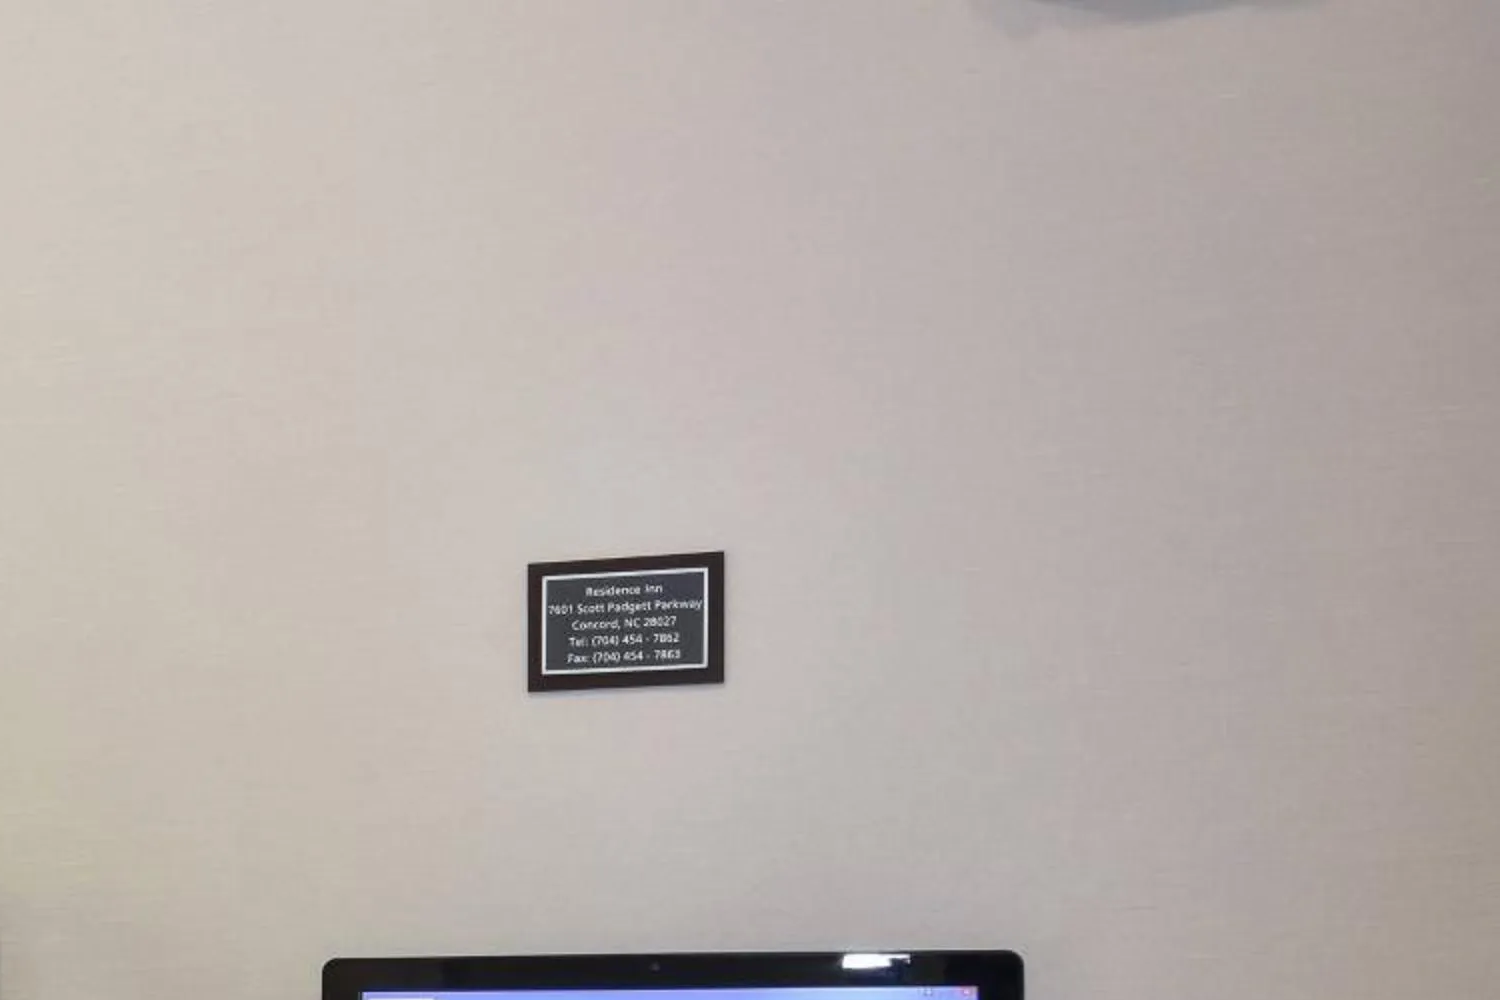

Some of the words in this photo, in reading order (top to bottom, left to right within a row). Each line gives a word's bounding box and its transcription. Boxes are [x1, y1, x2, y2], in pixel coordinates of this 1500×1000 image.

[585, 585, 641, 597] Residence
[645, 584, 663, 593] Inn
[548, 604, 573, 615] 7601
[577, 603, 605, 614] Scott
[607, 602, 652, 614] Padgett
[654, 600, 703, 611] Parkway
[571, 620, 621, 631] Concord,
[624, 618, 641, 628] NC
[643, 616, 677, 627] 28027
[568, 637, 589, 647] Tel:
[591, 634, 619, 647] (704)
[622, 633, 643, 645] 454
[567, 653, 589, 663] Fax:
[592, 651, 620, 664] (704)
[623, 650, 643, 661] 454
